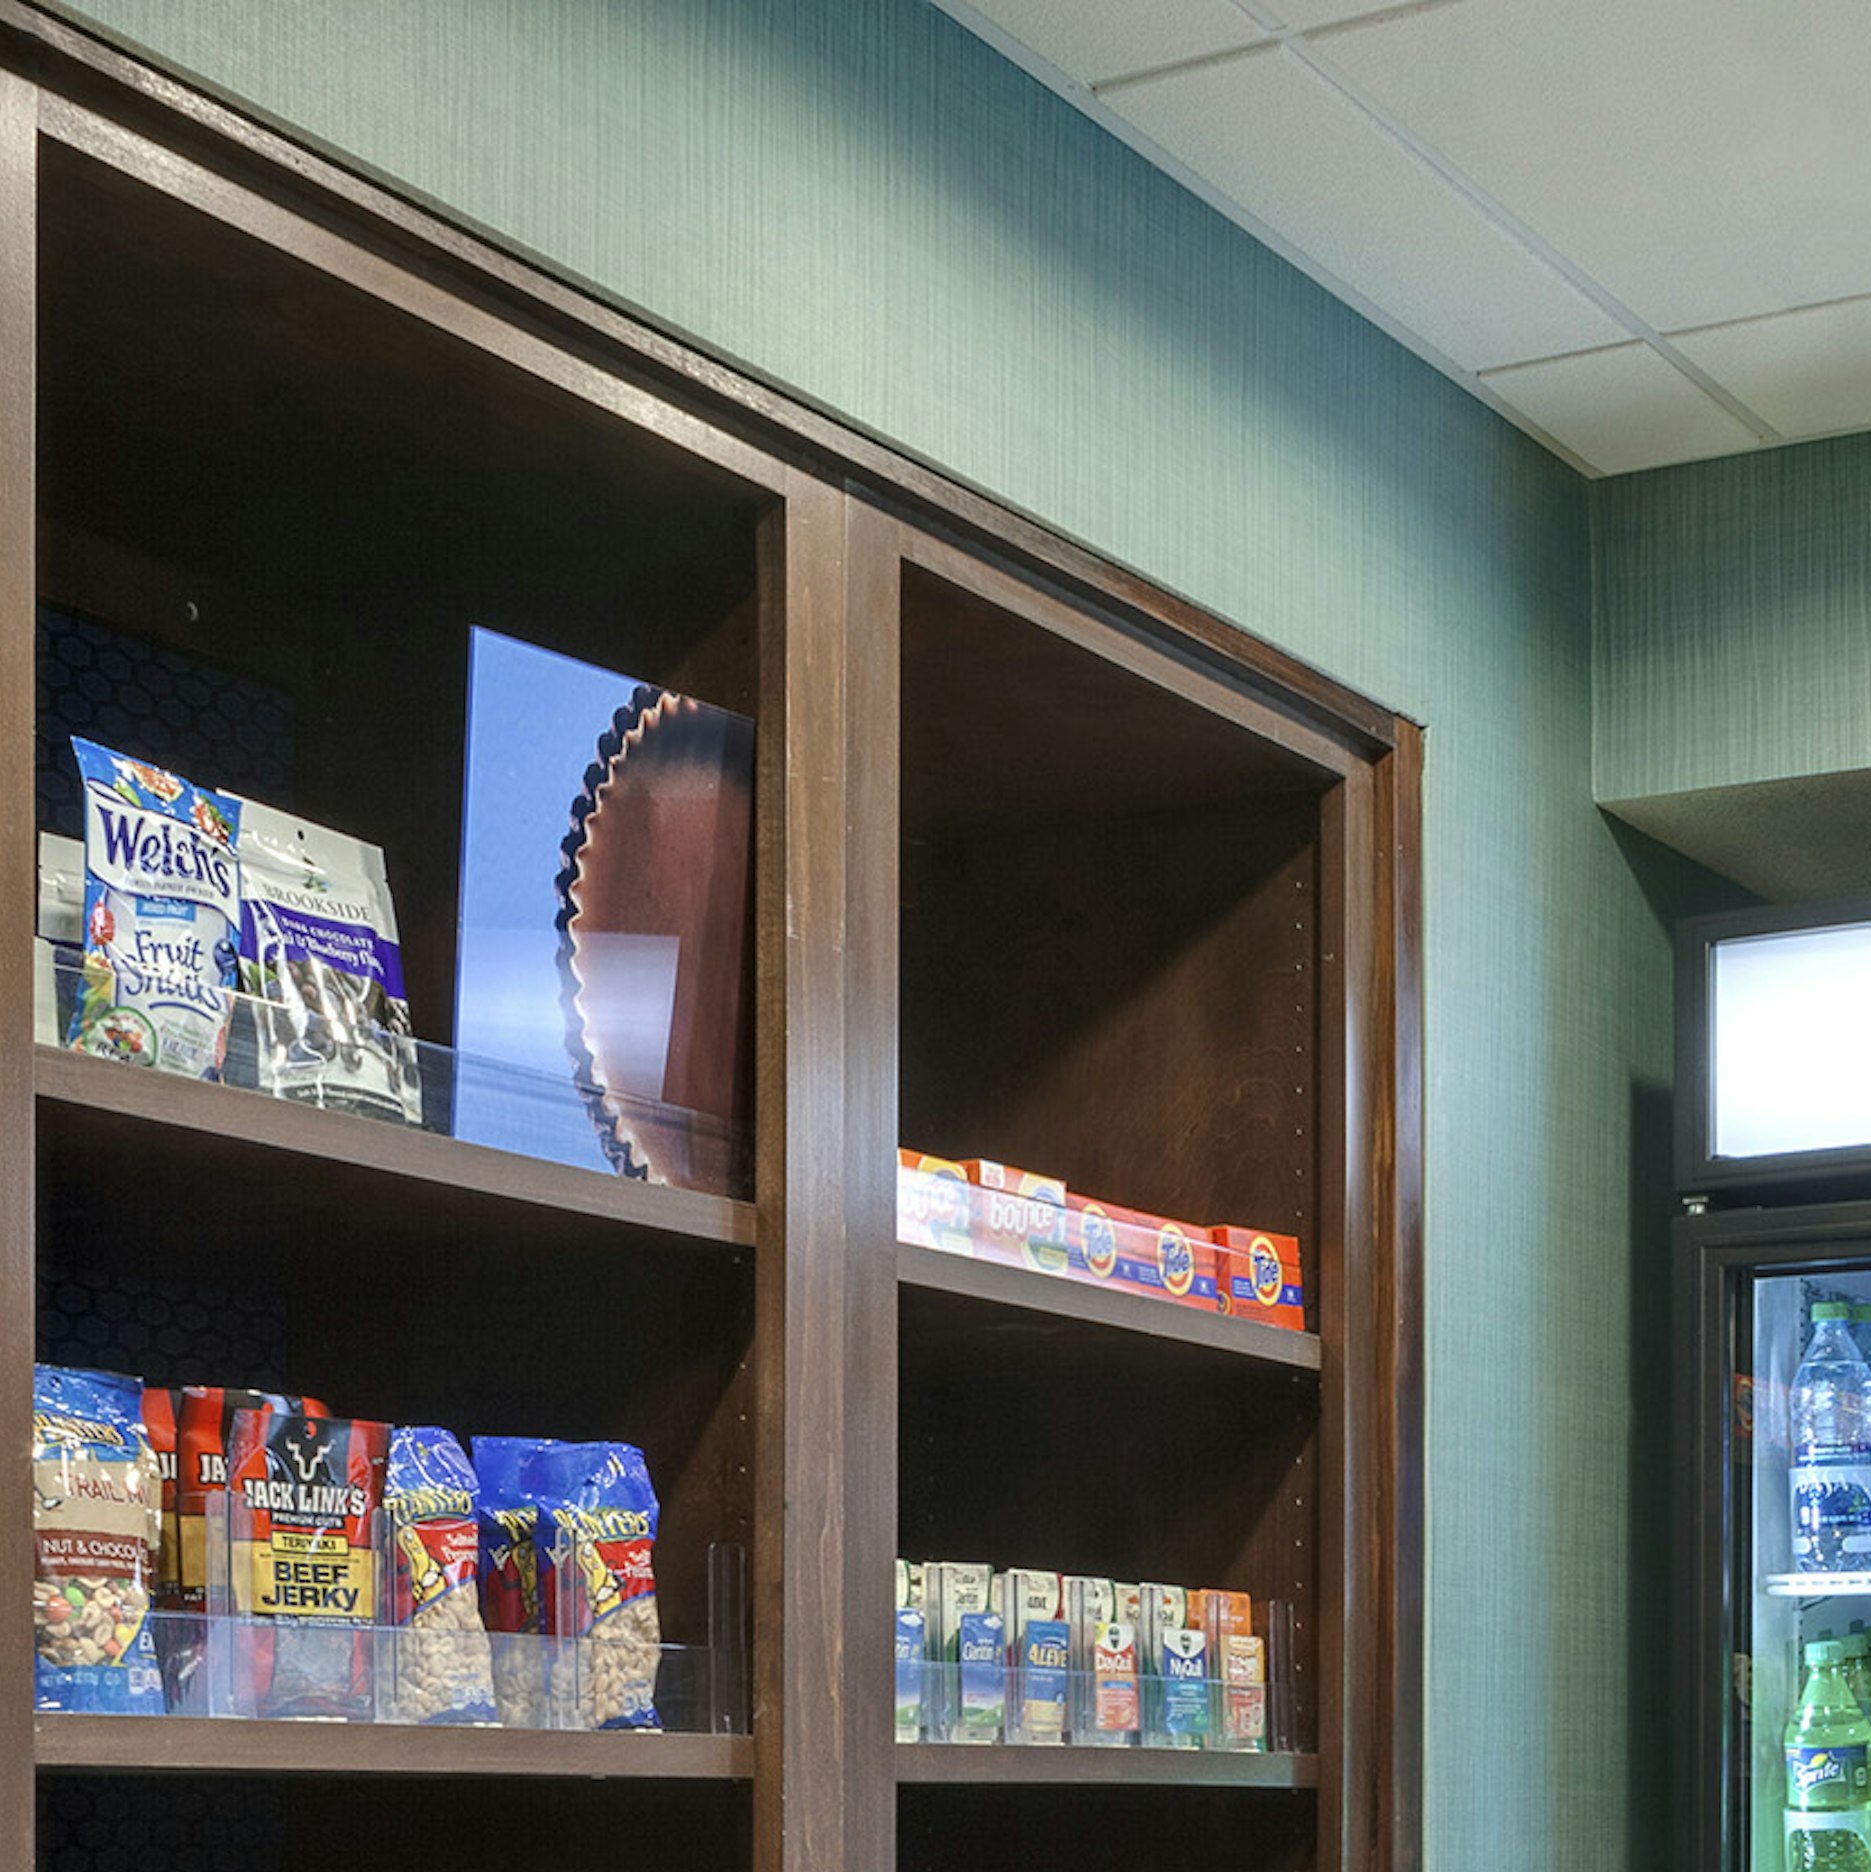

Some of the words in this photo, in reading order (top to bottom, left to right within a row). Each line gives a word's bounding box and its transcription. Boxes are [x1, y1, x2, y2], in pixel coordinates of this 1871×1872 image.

[96, 804, 229, 899] Welch's
[261, 881, 372, 922] BROOKSIDE
[134, 930, 204, 973] Fruit
[988, 1196, 1055, 1234] bounce
[1160, 1242, 1190, 1279] Tide
[1252, 1254, 1280, 1290] Tide
[243, 1479, 297, 1510] JACK
[298, 1482, 366, 1518] LINK'S
[42, 1538, 75, 1556] NUT
[274, 1561, 350, 1585] BEEF
[261, 1585, 360, 1612] JERKY
[1028, 1643, 1068, 1668] ALEVE
